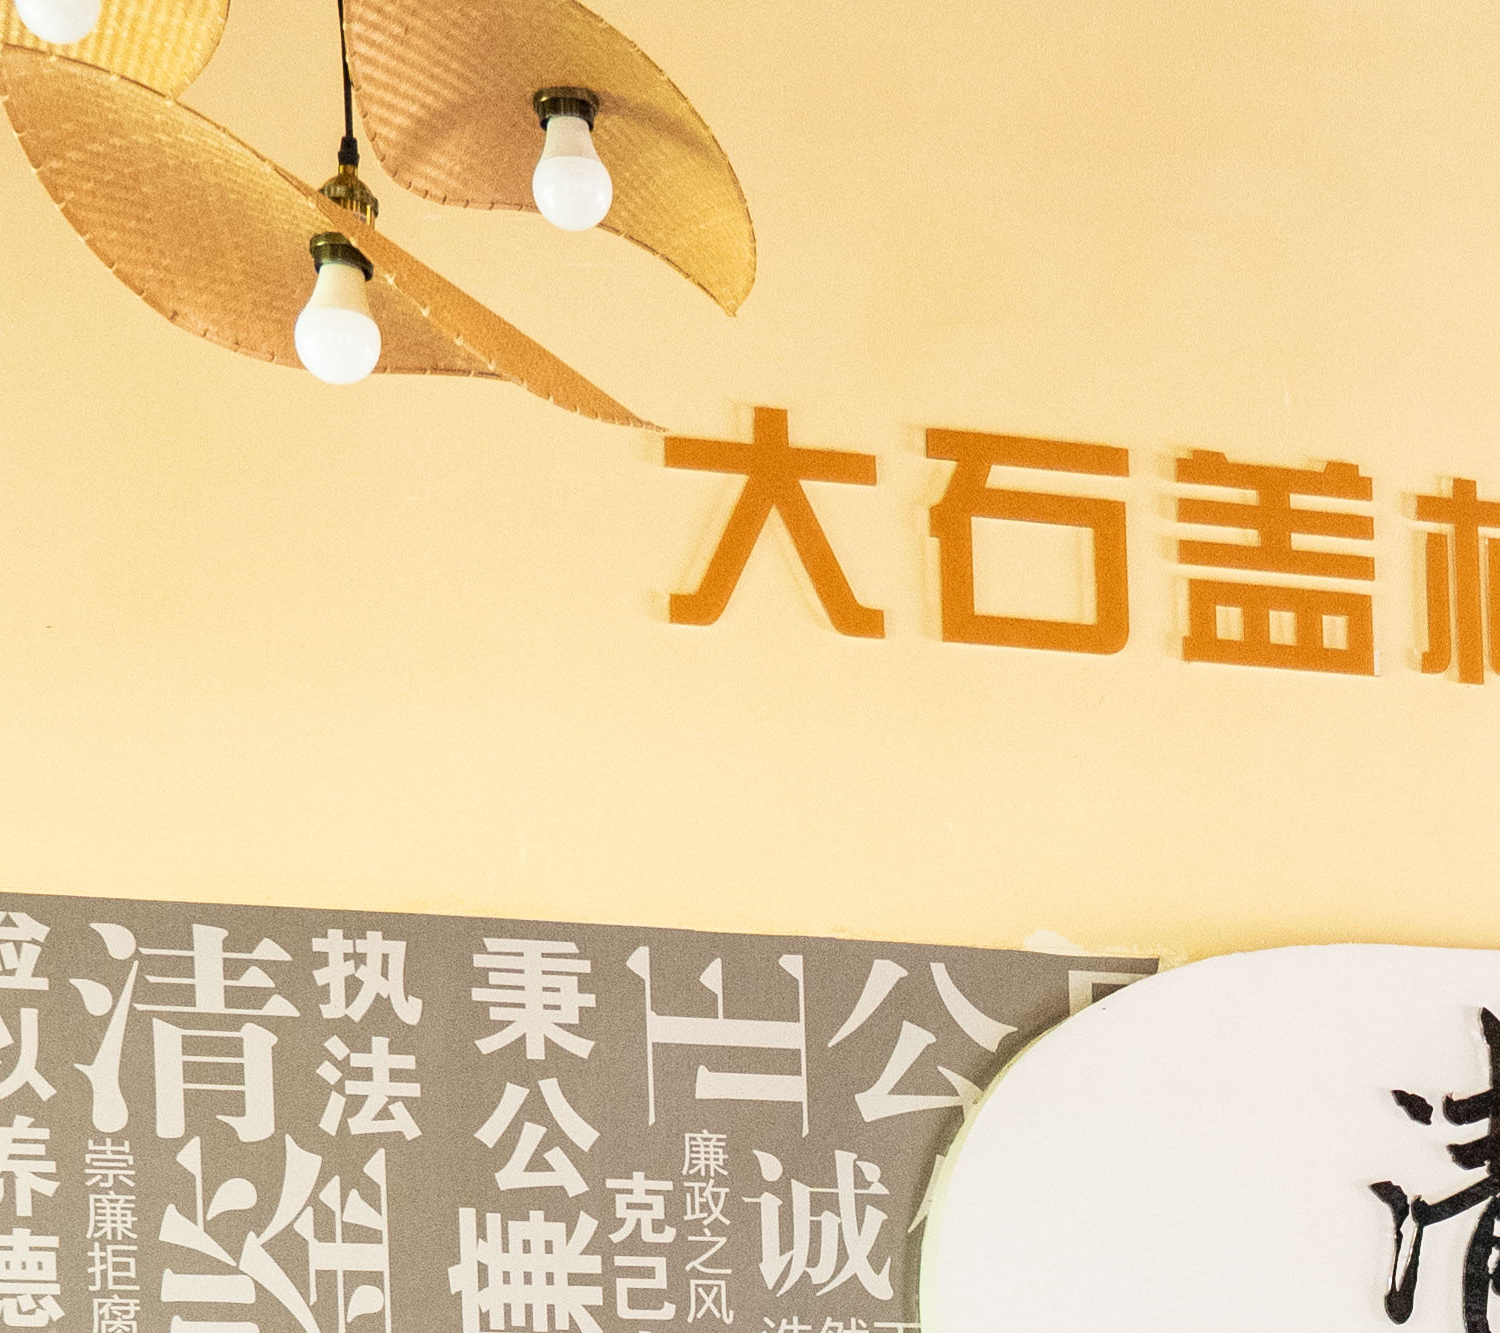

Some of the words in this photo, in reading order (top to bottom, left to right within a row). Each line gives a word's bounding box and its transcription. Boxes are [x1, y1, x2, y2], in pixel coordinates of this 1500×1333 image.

[70, 922, 300, 1142] 清
[310, 929, 423, 1140] 执法
[471, 936, 601, 1198] 秉公
[827, 958, 1018, 1122] 公
[682, 1129, 734, 1326] 廉政之风
[743, 1150, 940, 1300] 诚
